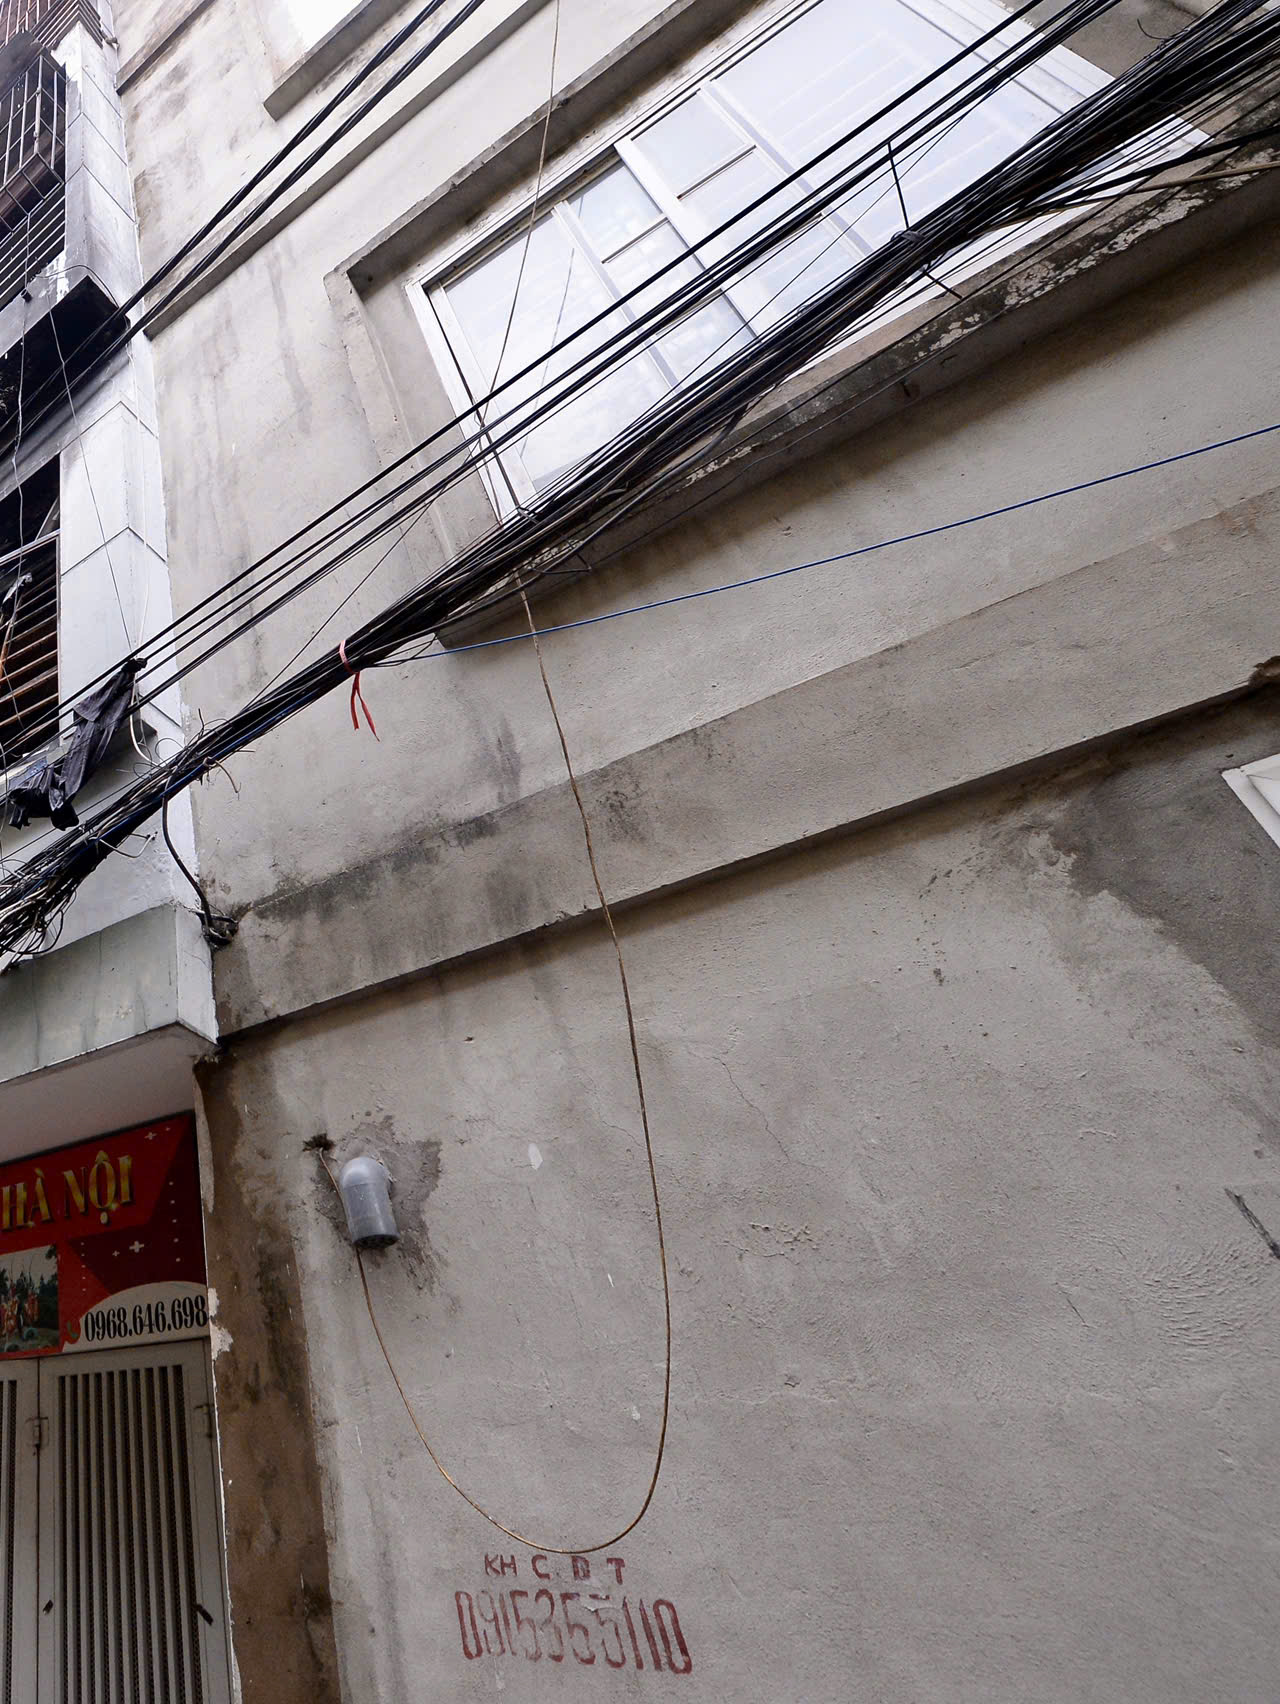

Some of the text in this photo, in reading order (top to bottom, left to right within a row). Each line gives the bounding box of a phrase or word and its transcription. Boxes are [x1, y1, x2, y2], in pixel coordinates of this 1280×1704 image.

[1, 1167, 54, 1231] HÀ
[63, 1150, 134, 1224] NỘI
[84, 1294, 208, 1342] 0968.646.698
[484, 1553, 517, 1577] KH
[606, 1557, 626, 1585] T
